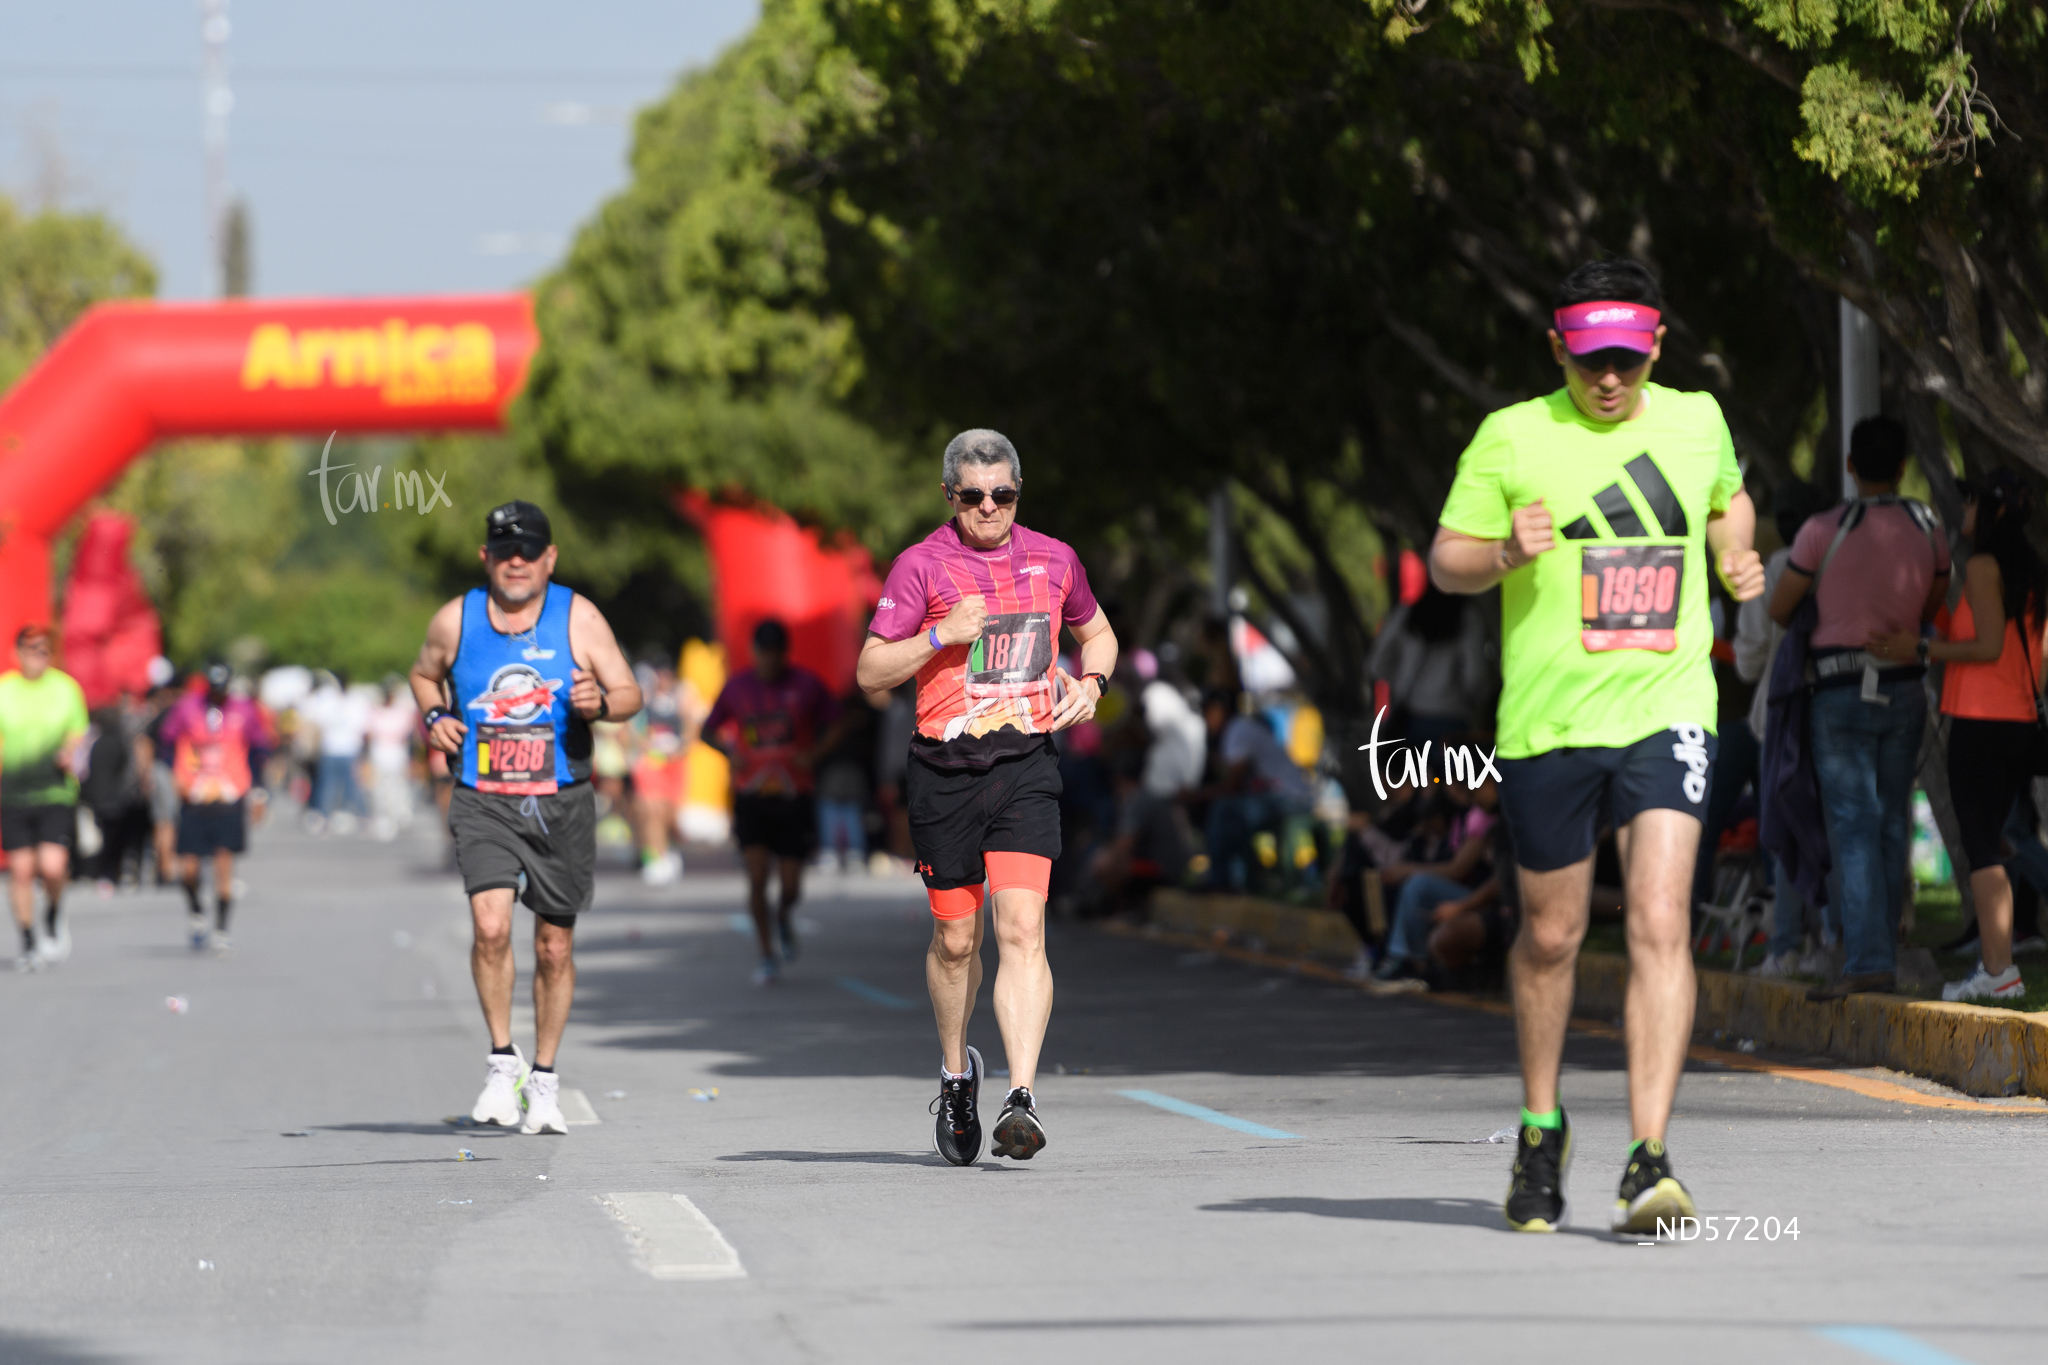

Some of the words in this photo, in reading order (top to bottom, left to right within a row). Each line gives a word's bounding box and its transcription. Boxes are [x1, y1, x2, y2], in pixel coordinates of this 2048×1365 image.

[1600, 565, 1677, 614] 1930
[986, 632, 1037, 670] 1877
[488, 738, 547, 772] 4268
